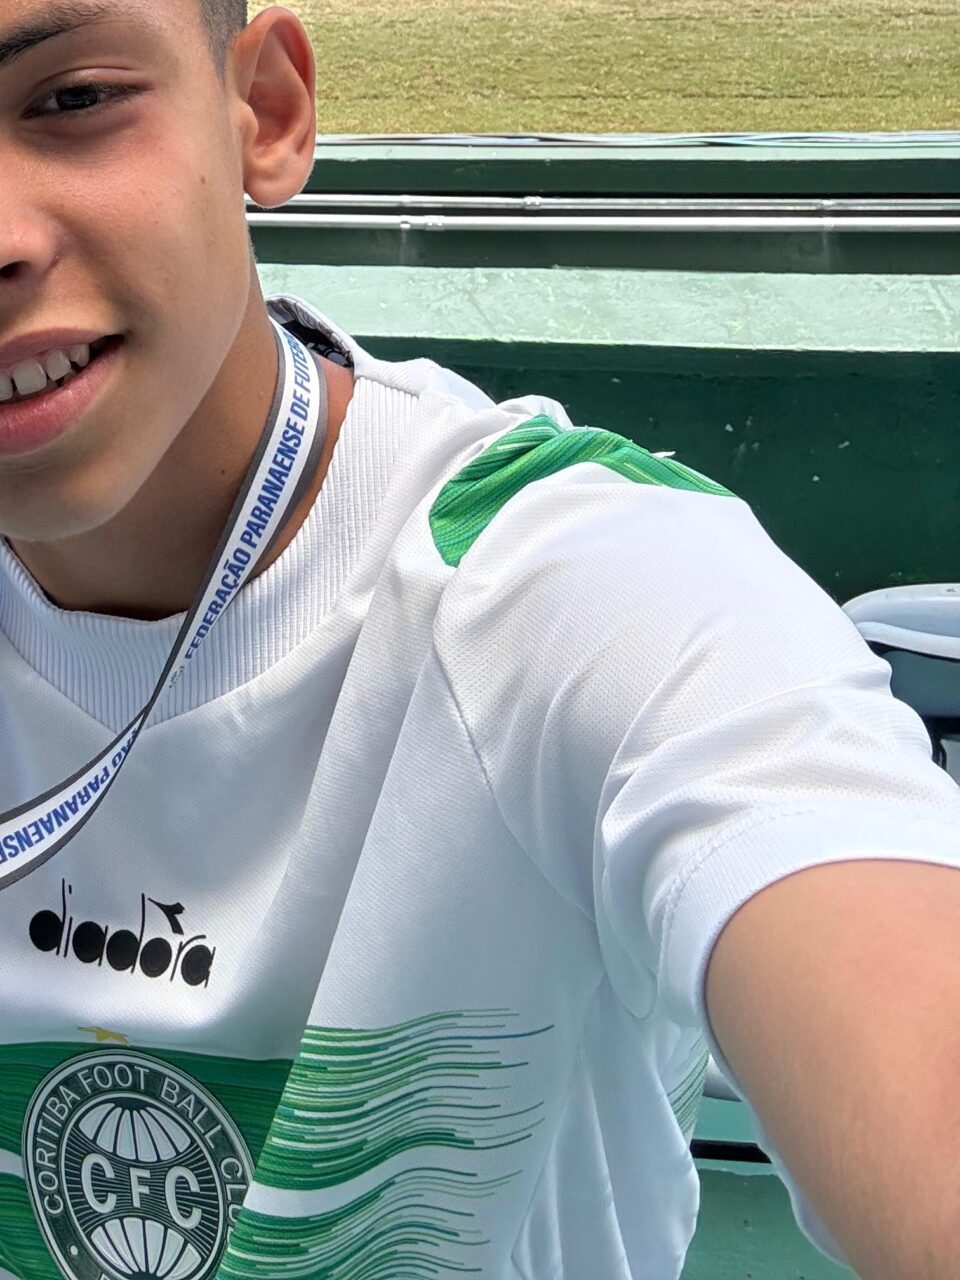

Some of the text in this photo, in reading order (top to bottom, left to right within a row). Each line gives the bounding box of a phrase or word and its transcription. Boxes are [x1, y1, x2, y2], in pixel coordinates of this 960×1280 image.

[184, 547, 252, 659] FEDERAÇÃO
[244, 418, 305, 550] PARANAENSE
[292, 388, 311, 421] DE
[29, 878, 216, 988] diadora
[35, 1082, 81, 1214] CORITIBA
[79, 1064, 150, 1095] FOOT
[161, 1077, 225, 1149] BALL
[81, 1154, 202, 1230] CFC
